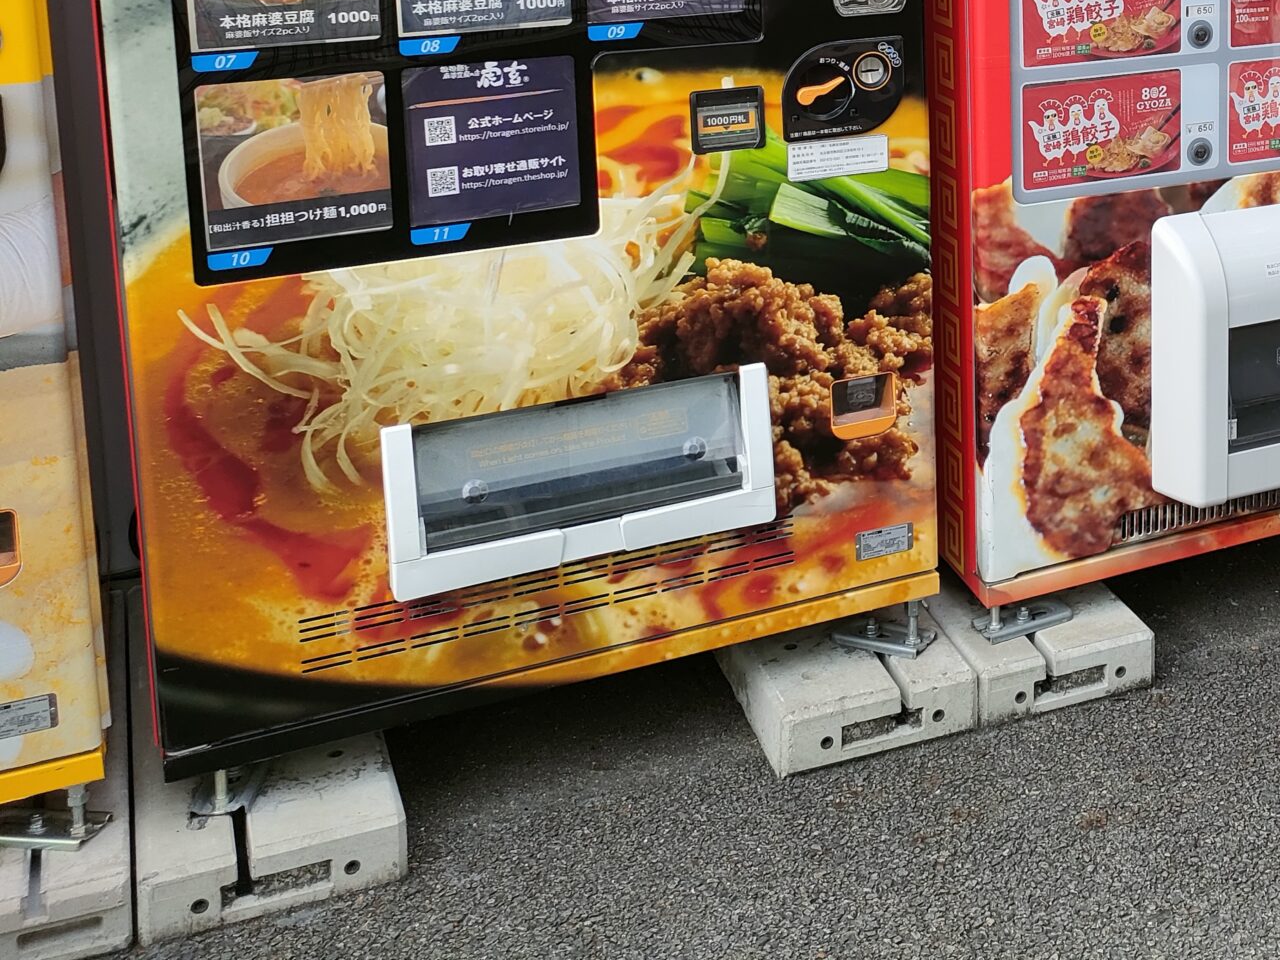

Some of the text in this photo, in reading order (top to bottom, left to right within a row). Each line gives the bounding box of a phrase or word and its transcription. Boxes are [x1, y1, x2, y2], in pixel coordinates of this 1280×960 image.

[219, 9, 379, 28] 本格麻婆豆腐 1000円
[607, 26, 626, 38] 09
[420, 40, 440, 53] 08
[214, 55, 236, 69] 07
[476, 61, 528, 88] 虎玄
[1141, 85, 1168, 99] 802
[1136, 98, 1172, 110] GYOZA
[467, 109, 554, 129] 公式ホームページ
[462, 155, 566, 178] お取り寄せ通販サイト
[433, 227, 449, 241] 11
[230, 252, 250, 266] 10
